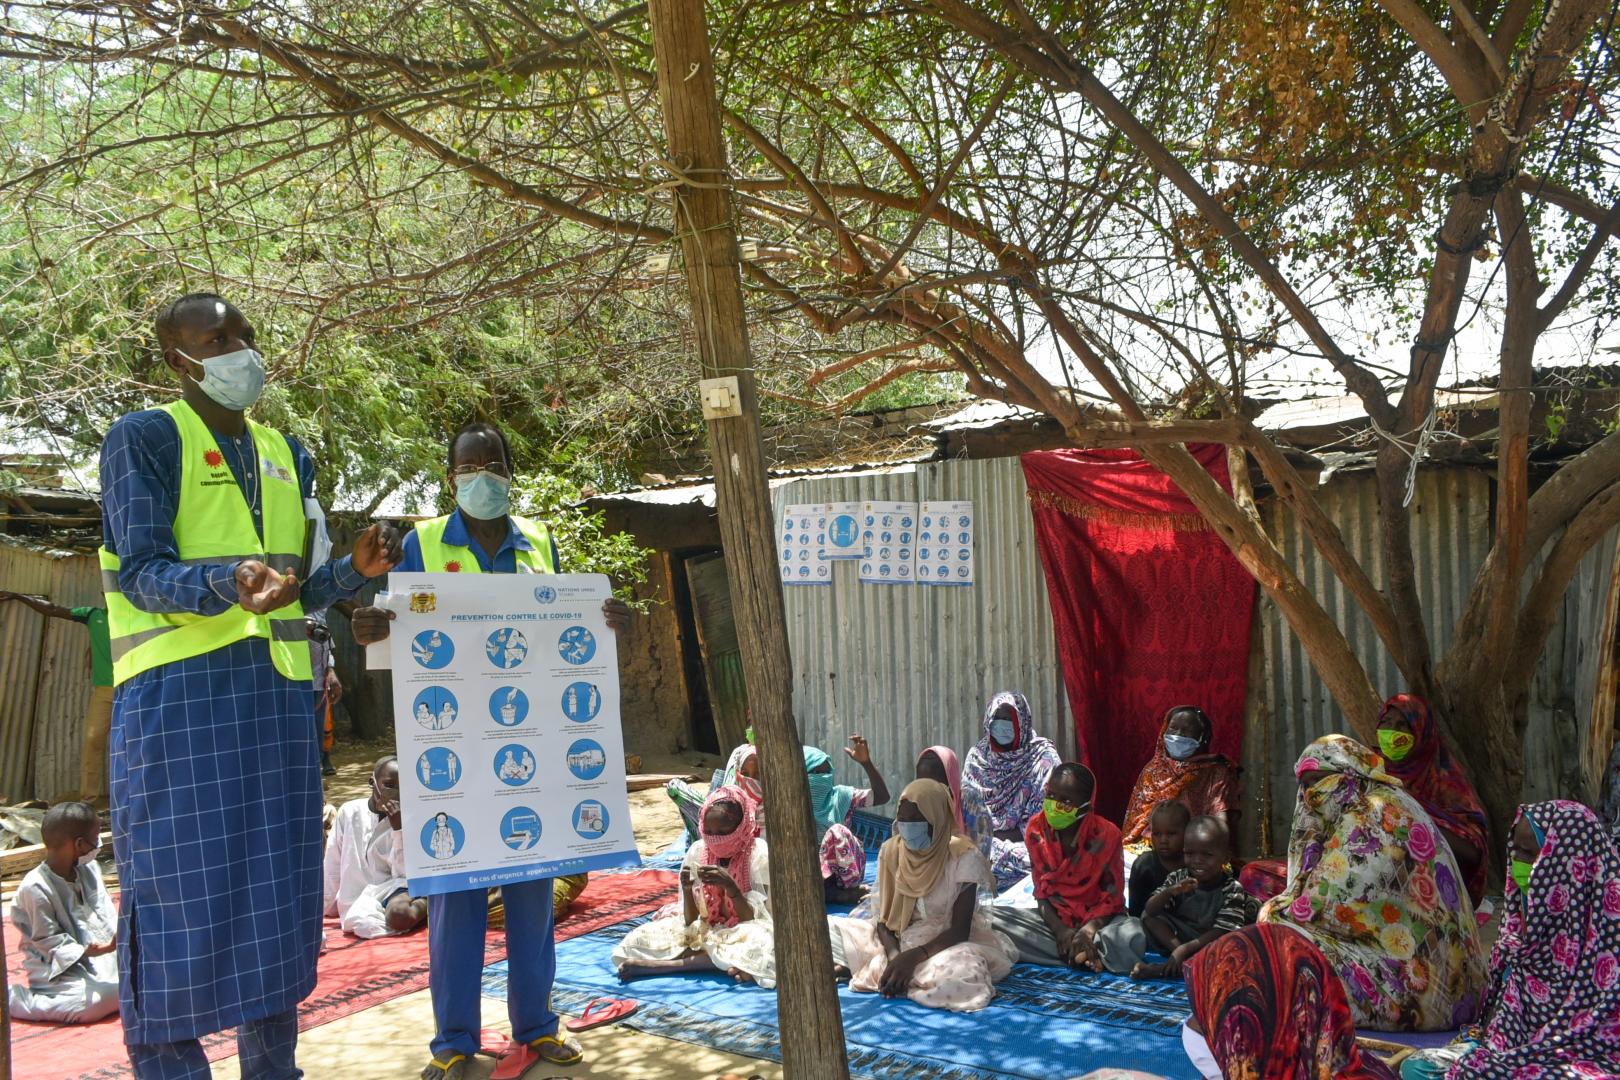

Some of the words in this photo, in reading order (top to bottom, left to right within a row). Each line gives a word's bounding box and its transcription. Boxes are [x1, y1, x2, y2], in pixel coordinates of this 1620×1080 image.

[469, 876, 478, 884] En
[479, 875, 490, 883] cas
[491, 871, 524, 881] d'urgence
